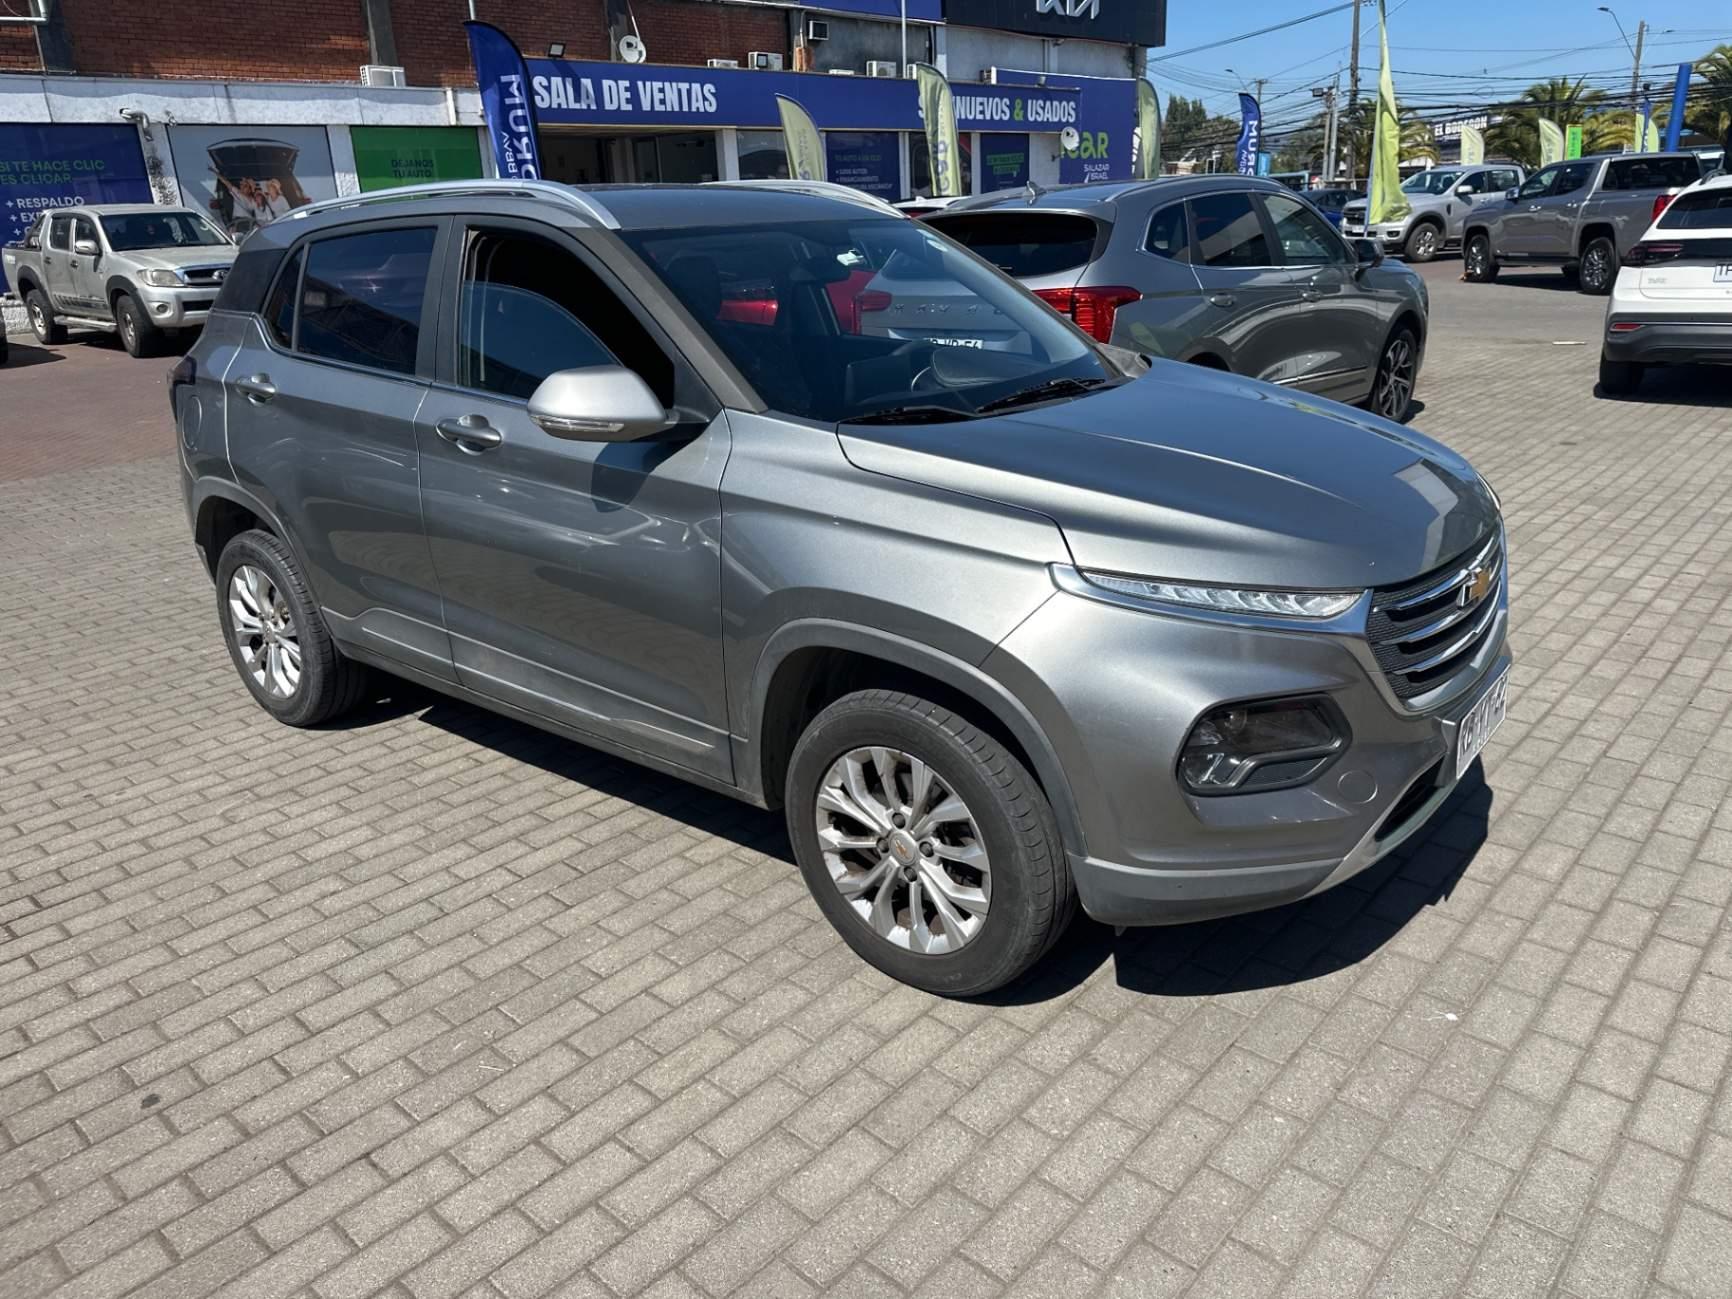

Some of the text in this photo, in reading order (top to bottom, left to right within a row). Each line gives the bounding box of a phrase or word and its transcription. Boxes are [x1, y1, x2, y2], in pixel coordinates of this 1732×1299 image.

[532, 75, 717, 113] SALA DE VENTAS
[1013, 98, 1024, 122] &
[1027, 99, 1076, 123] USADOS
[14, 161, 30, 172] TE
[32, 160, 71, 172] HACE
[73, 159, 105, 171] CLIC
[16, 196, 85, 209] RESPALDO
